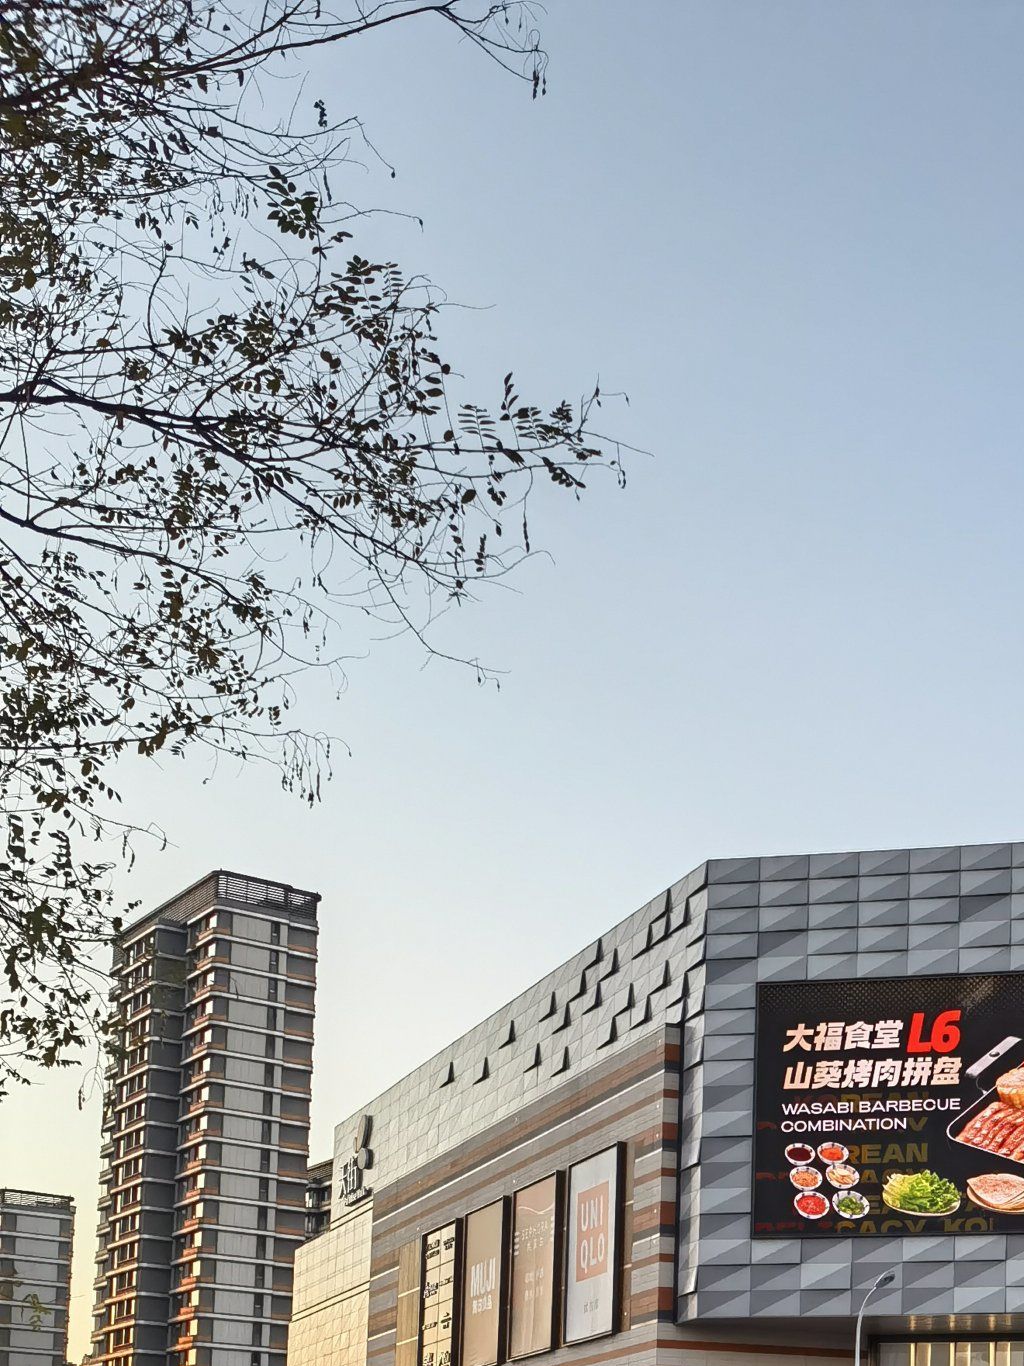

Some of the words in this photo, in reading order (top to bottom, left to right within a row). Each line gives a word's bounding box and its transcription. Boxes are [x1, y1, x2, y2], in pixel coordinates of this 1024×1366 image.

[782, 1019, 904, 1052] 大福食堂
[906, 1009, 962, 1054] L6
[782, 1056, 963, 1090] 山葵烤肉拼盘
[780, 1117, 907, 1133] COMBINATION
[781, 1102, 854, 1116] WASABI
[581, 1195, 604, 1232] UNI
[580, 1233, 605, 1274] QLO
[470, 1257, 496, 1298] MUJI
